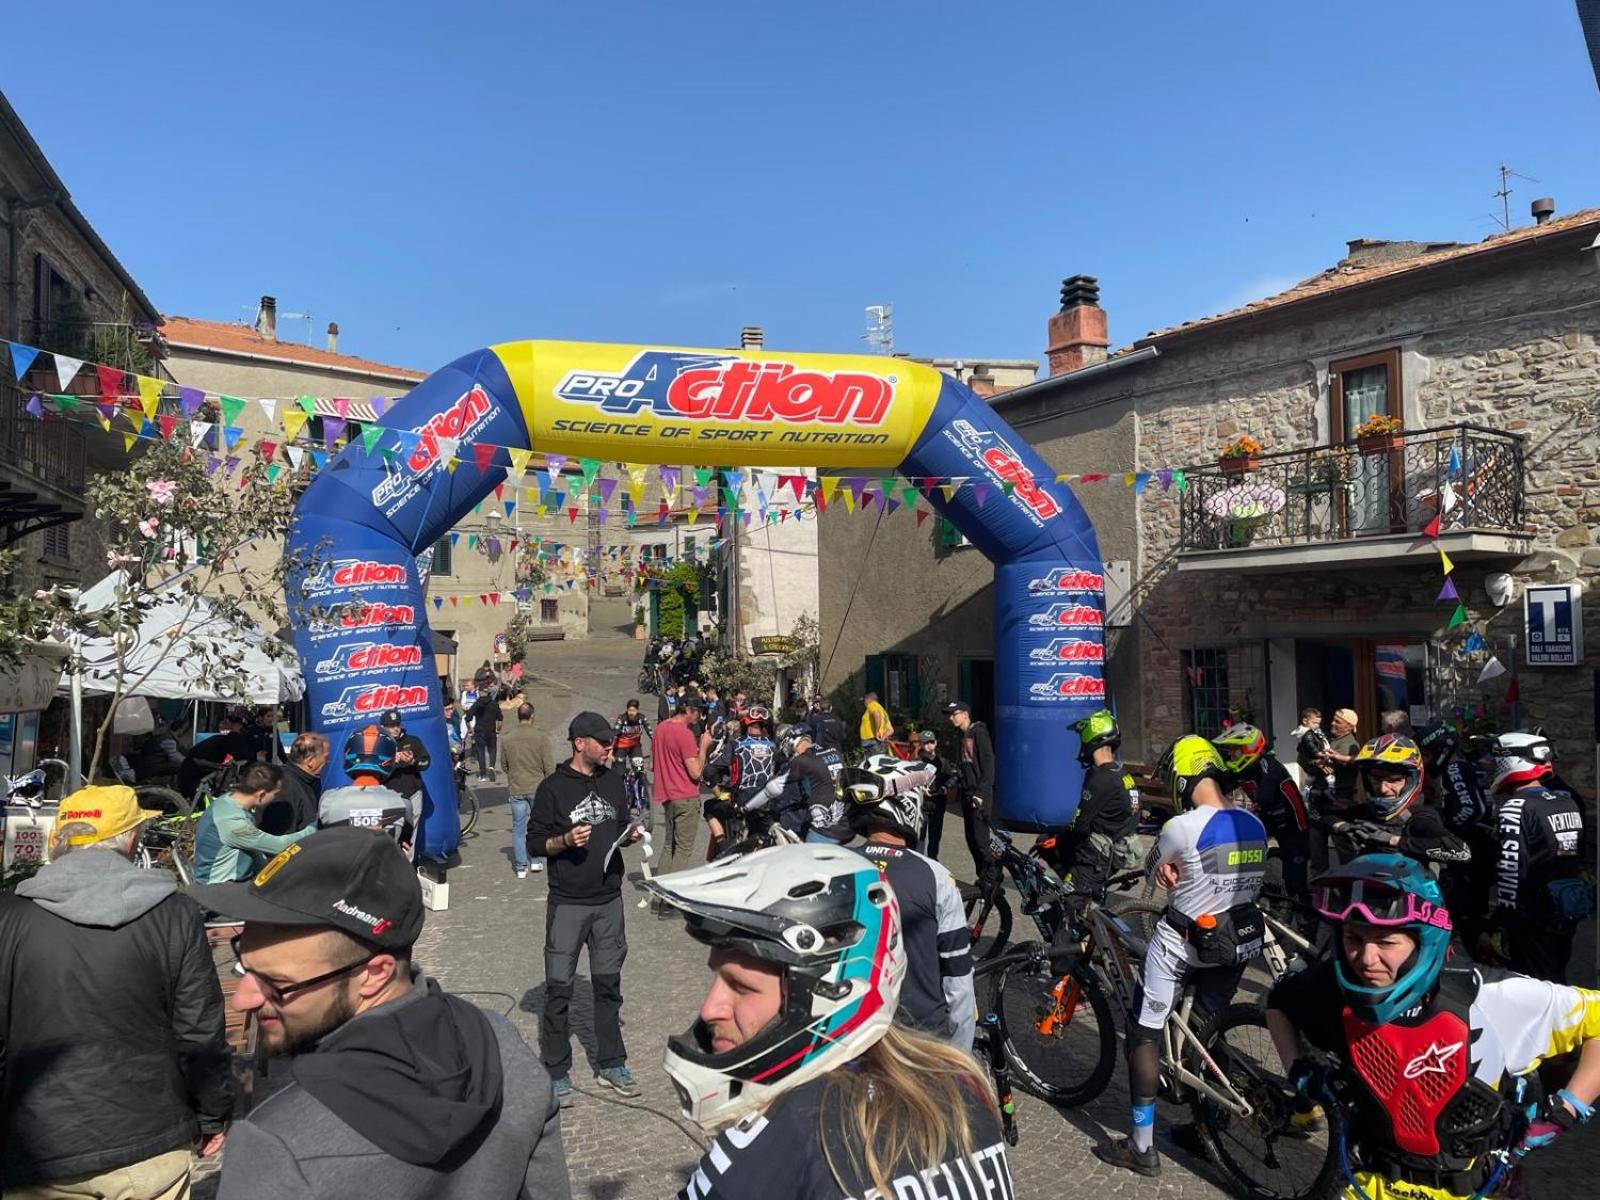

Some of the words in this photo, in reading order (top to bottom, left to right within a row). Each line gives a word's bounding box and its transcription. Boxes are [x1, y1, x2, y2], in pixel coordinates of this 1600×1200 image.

[563, 375, 644, 399] PRO
[552, 419, 654, 436] SCIENCE
[660, 426, 691, 438] OF
[697, 428, 773, 442] SPORT
[781, 431, 888, 444] NUTRITION
[386, 484, 421, 519] SCIENCE
[463, 406, 500, 446] NUTRITION
[942, 429, 974, 460] SCIENCE
[1008, 494, 1045, 528] NUTRITION
[1530, 590, 1567, 642] T
[66, 808, 102, 819] Benelli
[353, 817, 379, 827] 505
[1499, 798, 1526, 835] BIKE
[1228, 849, 1262, 865] GROSSI
[1498, 839, 1520, 910] SERVICE
[332, 899, 381, 926] Andreani
